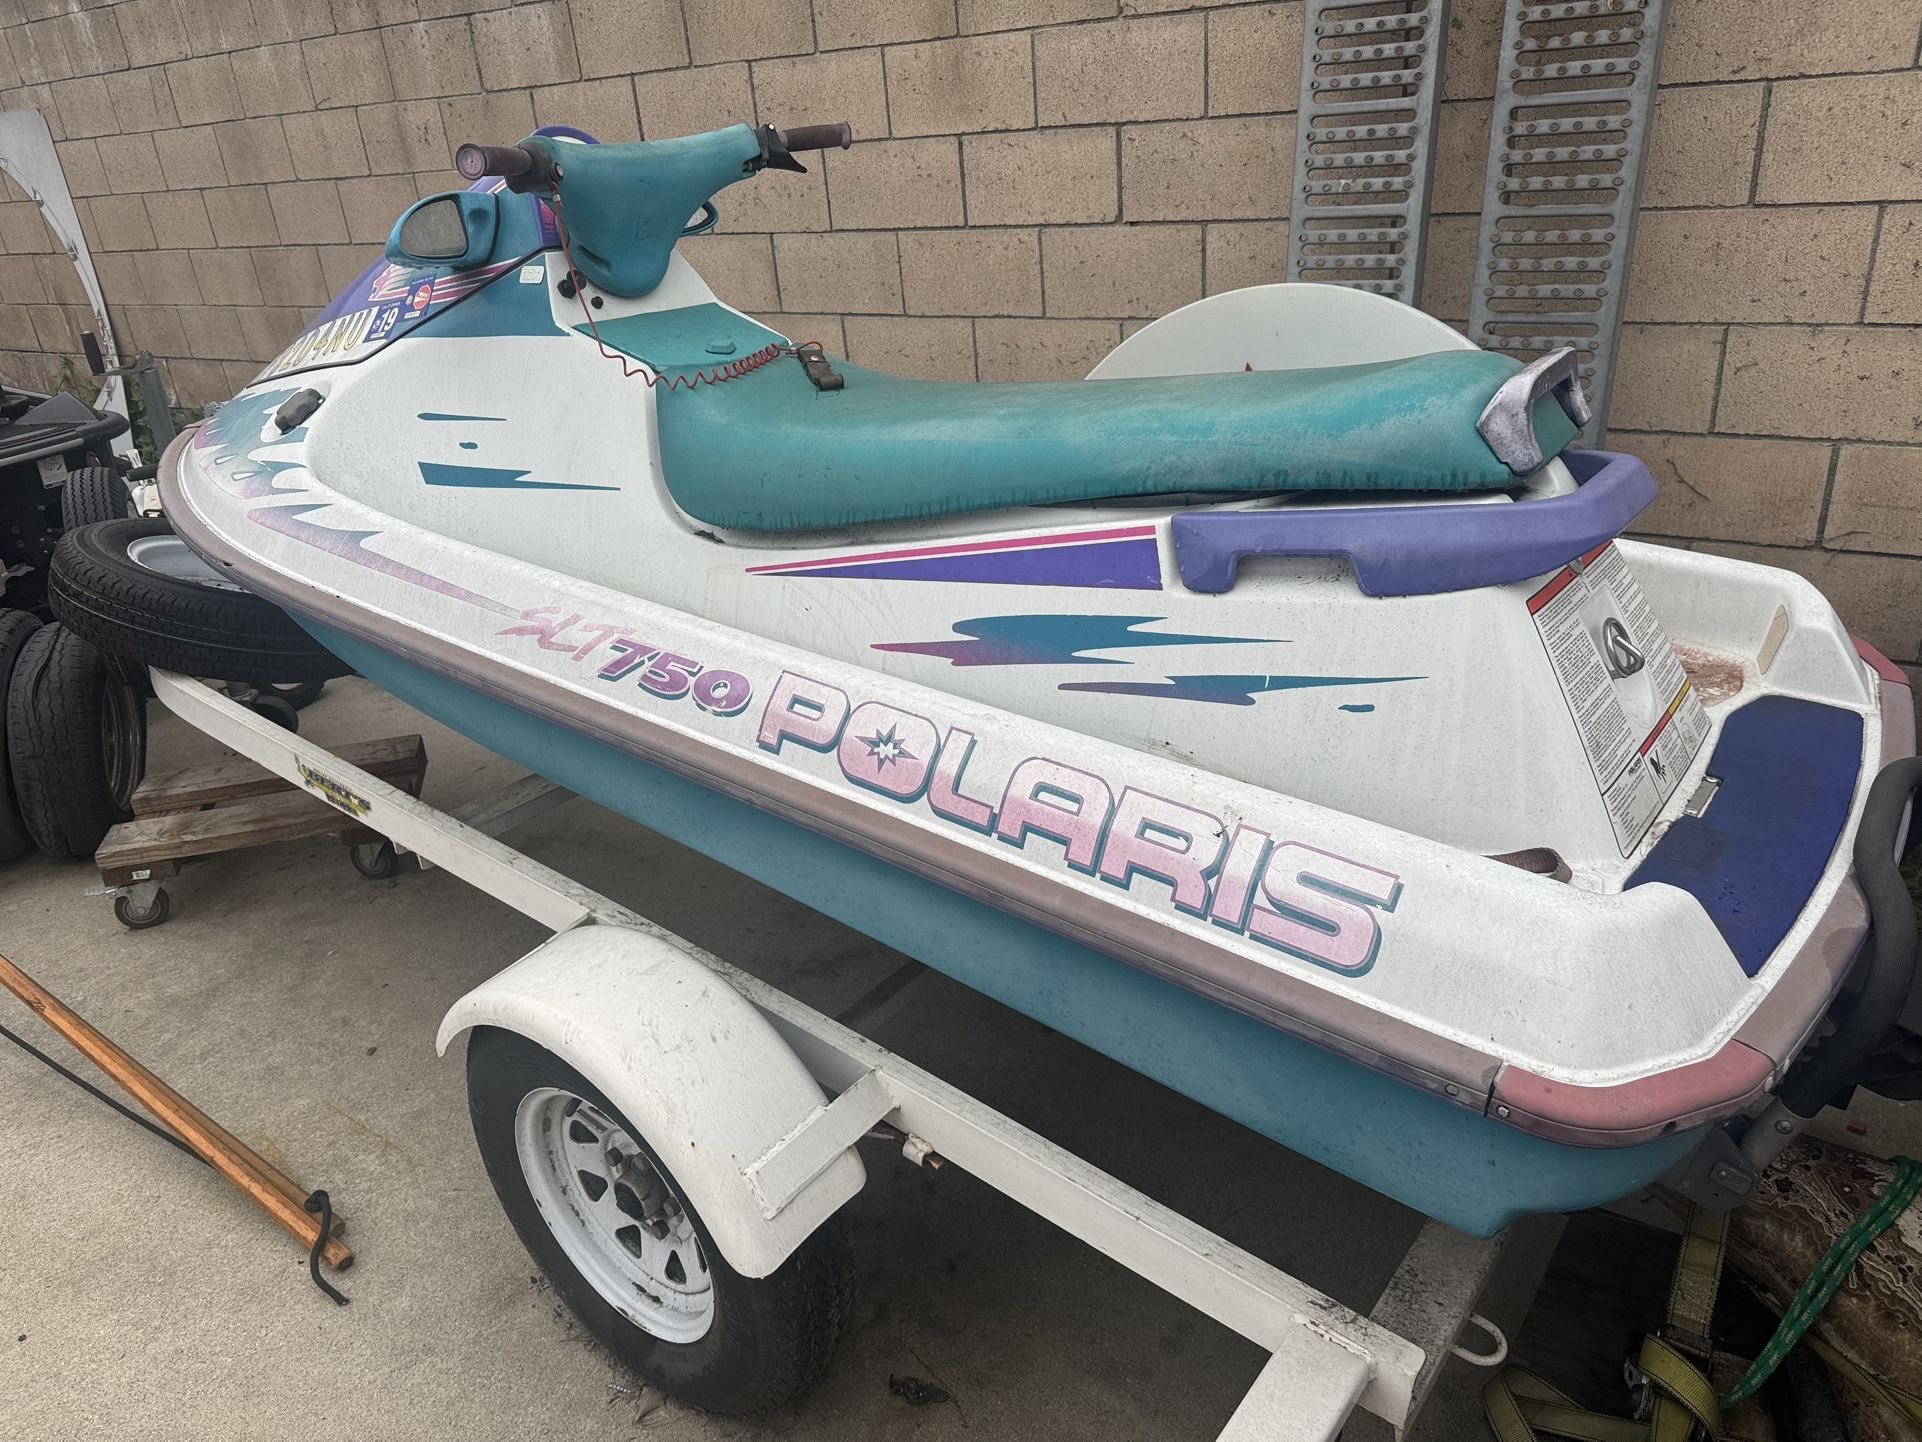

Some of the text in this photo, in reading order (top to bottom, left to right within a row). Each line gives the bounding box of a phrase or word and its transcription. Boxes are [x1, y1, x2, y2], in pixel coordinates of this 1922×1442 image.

[378, 307, 399, 333] 19
[494, 606, 753, 718] SLT 750
[757, 669, 1404, 978] POLARIS
